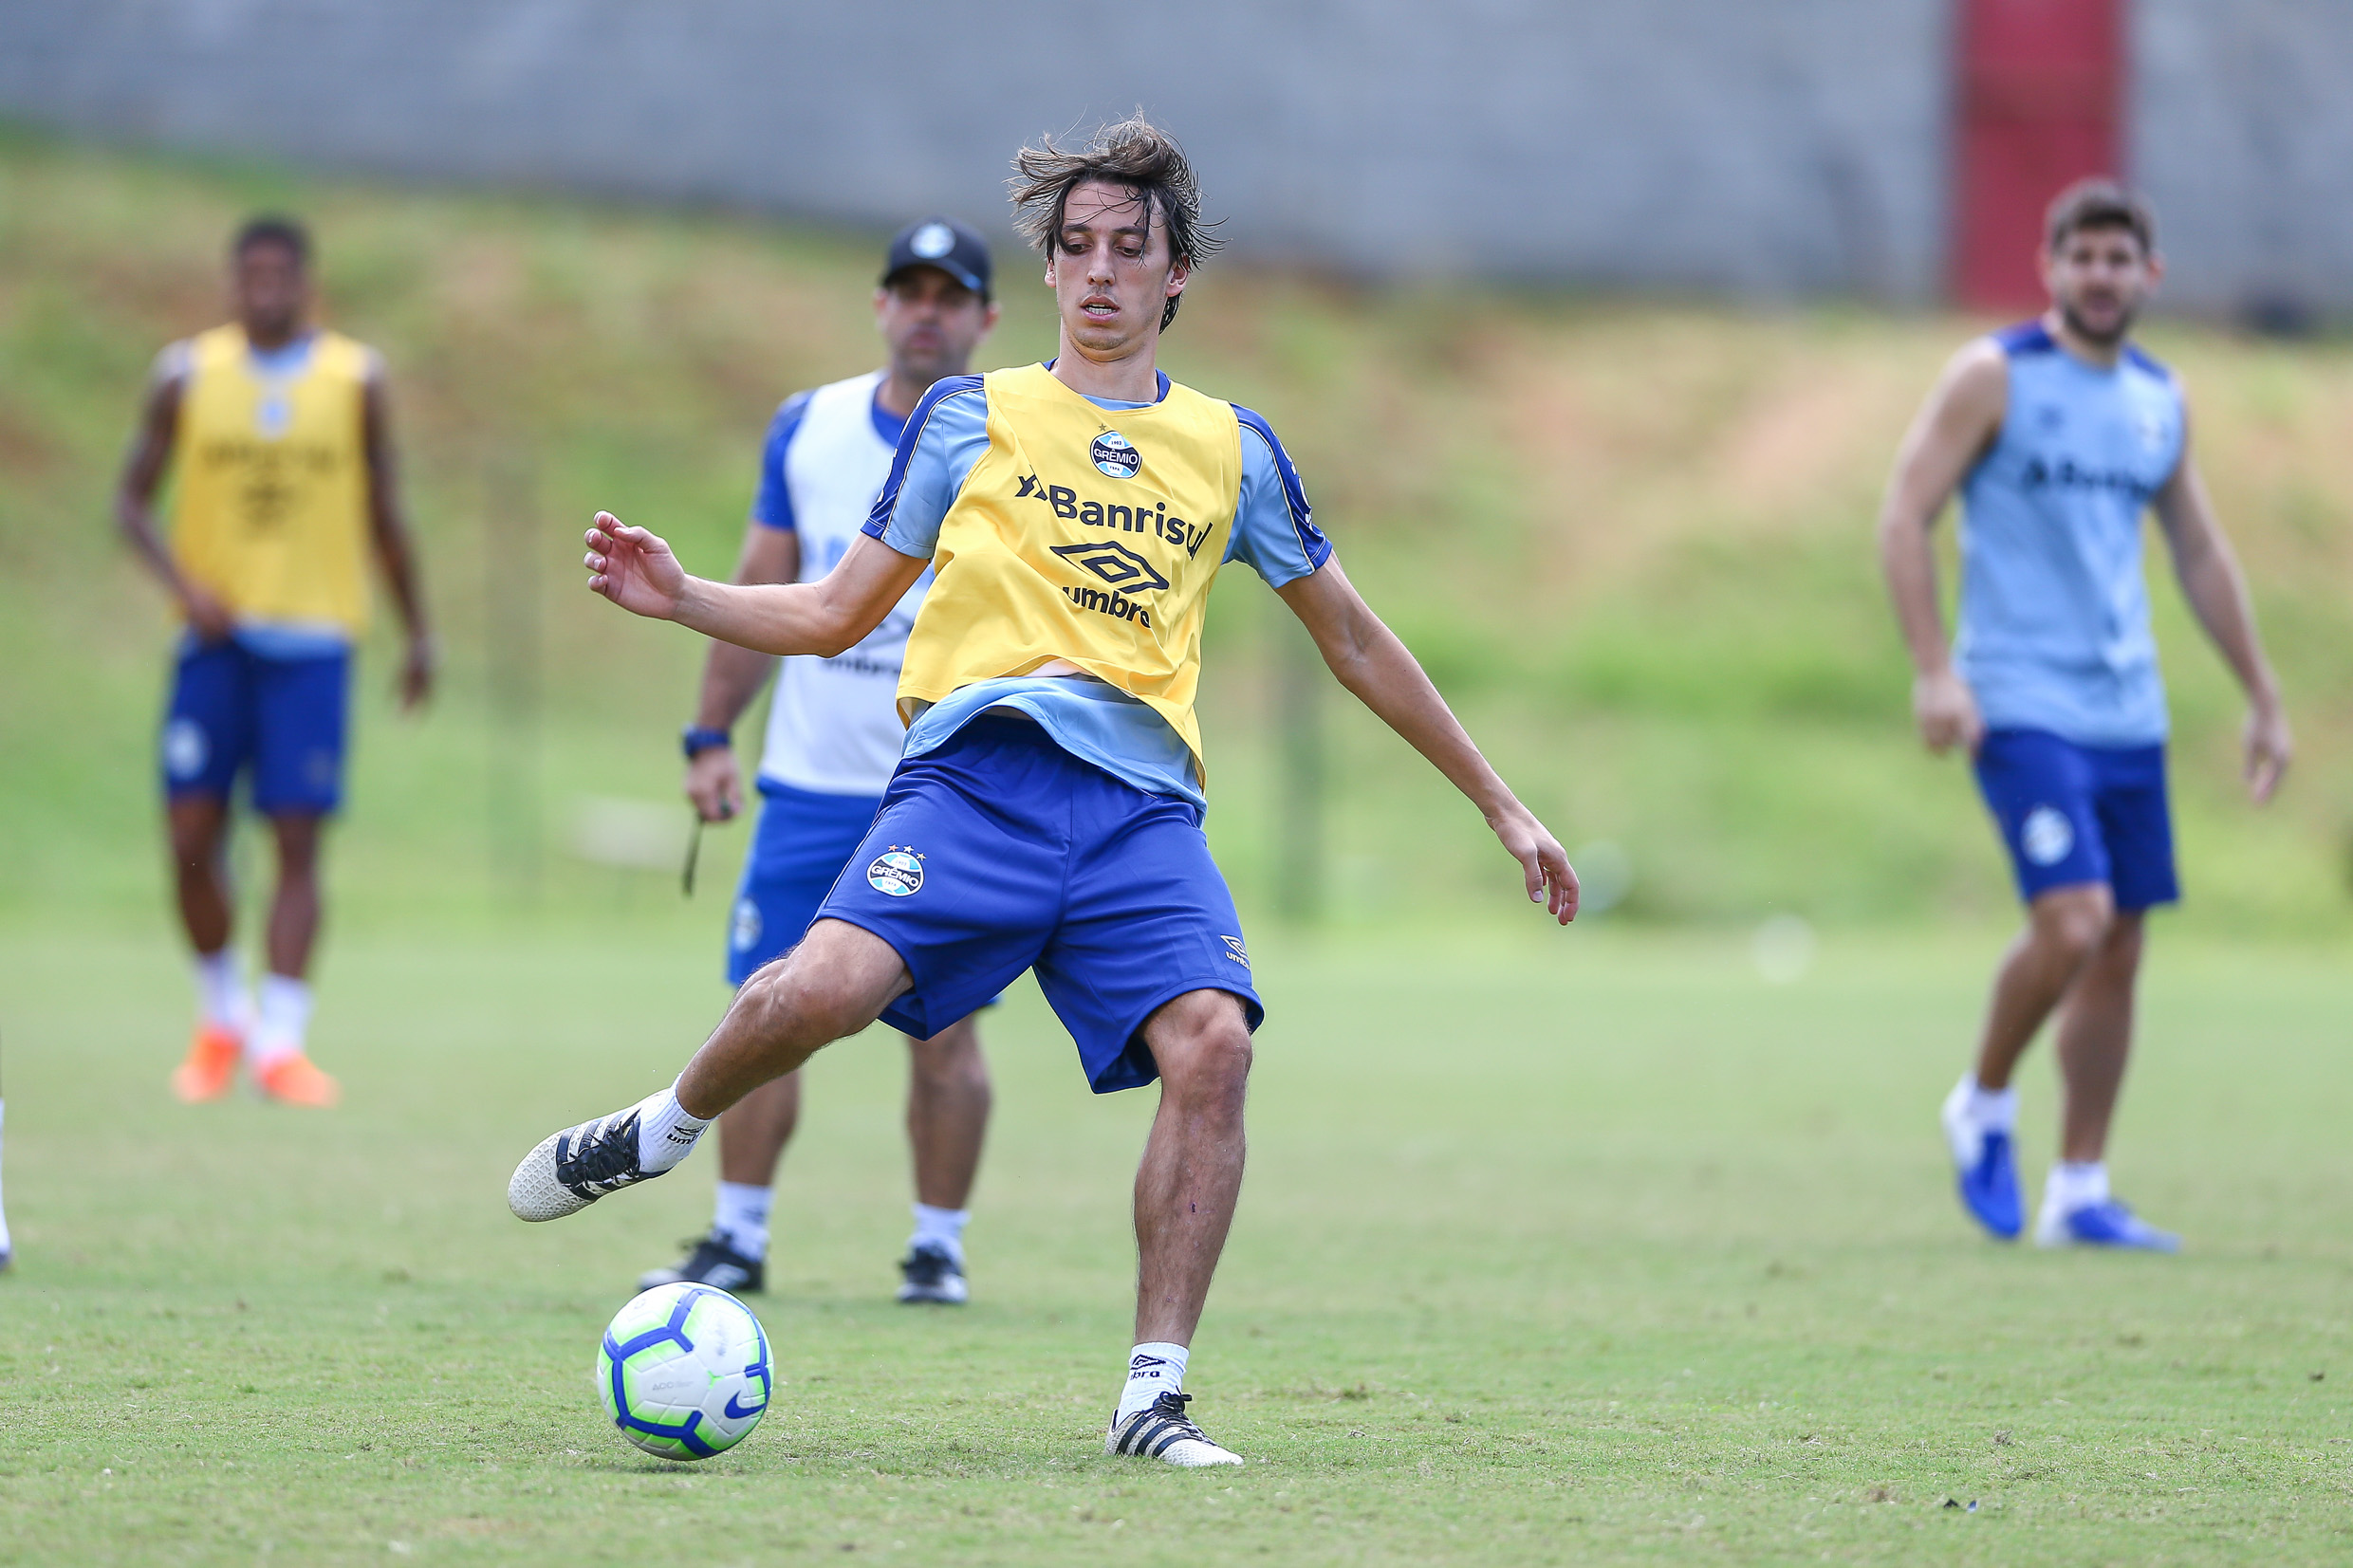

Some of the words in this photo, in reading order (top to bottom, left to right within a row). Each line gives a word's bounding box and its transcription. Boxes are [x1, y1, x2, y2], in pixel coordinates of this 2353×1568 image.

[1094, 448, 1139, 465] GRÊMIO
[1048, 485, 1214, 562] Banrisul
[1062, 586, 1151, 629] umbro
[871, 865, 919, 888] GRÊMIO
[1225, 950, 1250, 970] umb
